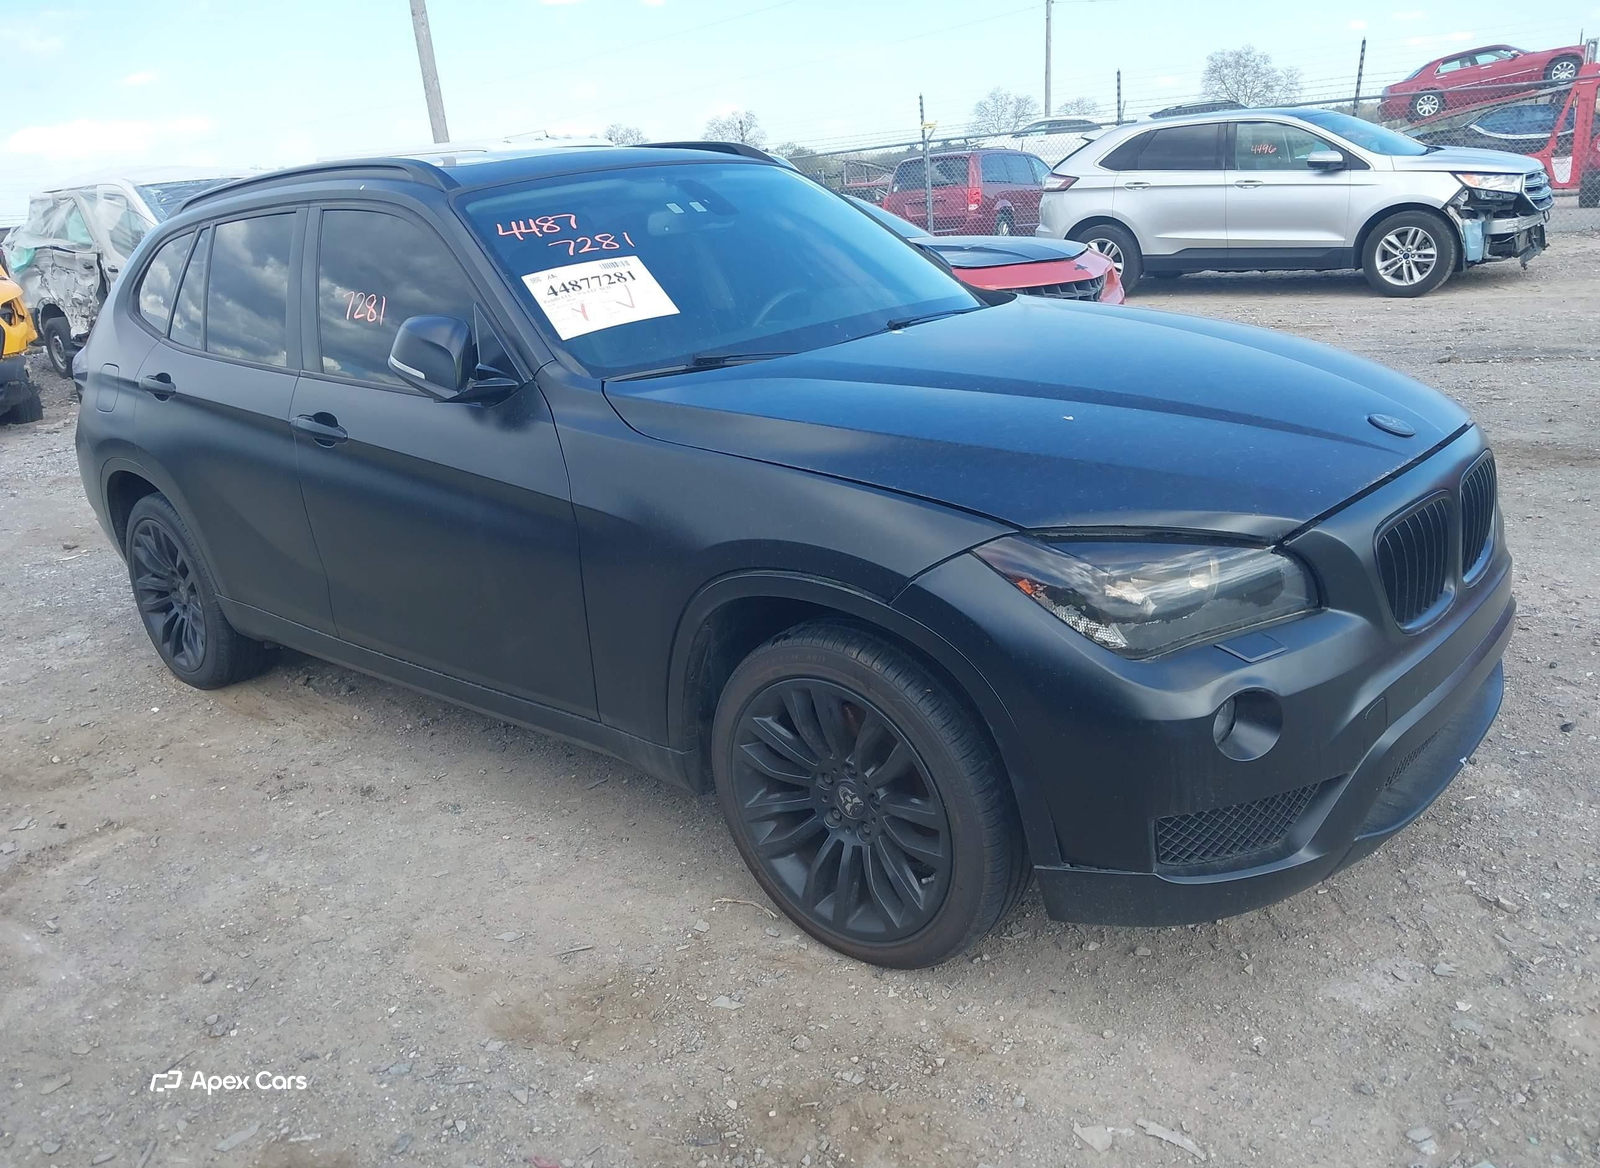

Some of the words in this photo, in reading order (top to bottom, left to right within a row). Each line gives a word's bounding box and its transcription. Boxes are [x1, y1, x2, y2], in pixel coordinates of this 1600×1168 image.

[1250, 144, 1277, 154] 4496
[496, 213, 577, 241] 4487
[548, 232, 635, 256] 7281
[546, 270, 636, 297] 44877281
[343, 291, 386, 325] 7281
